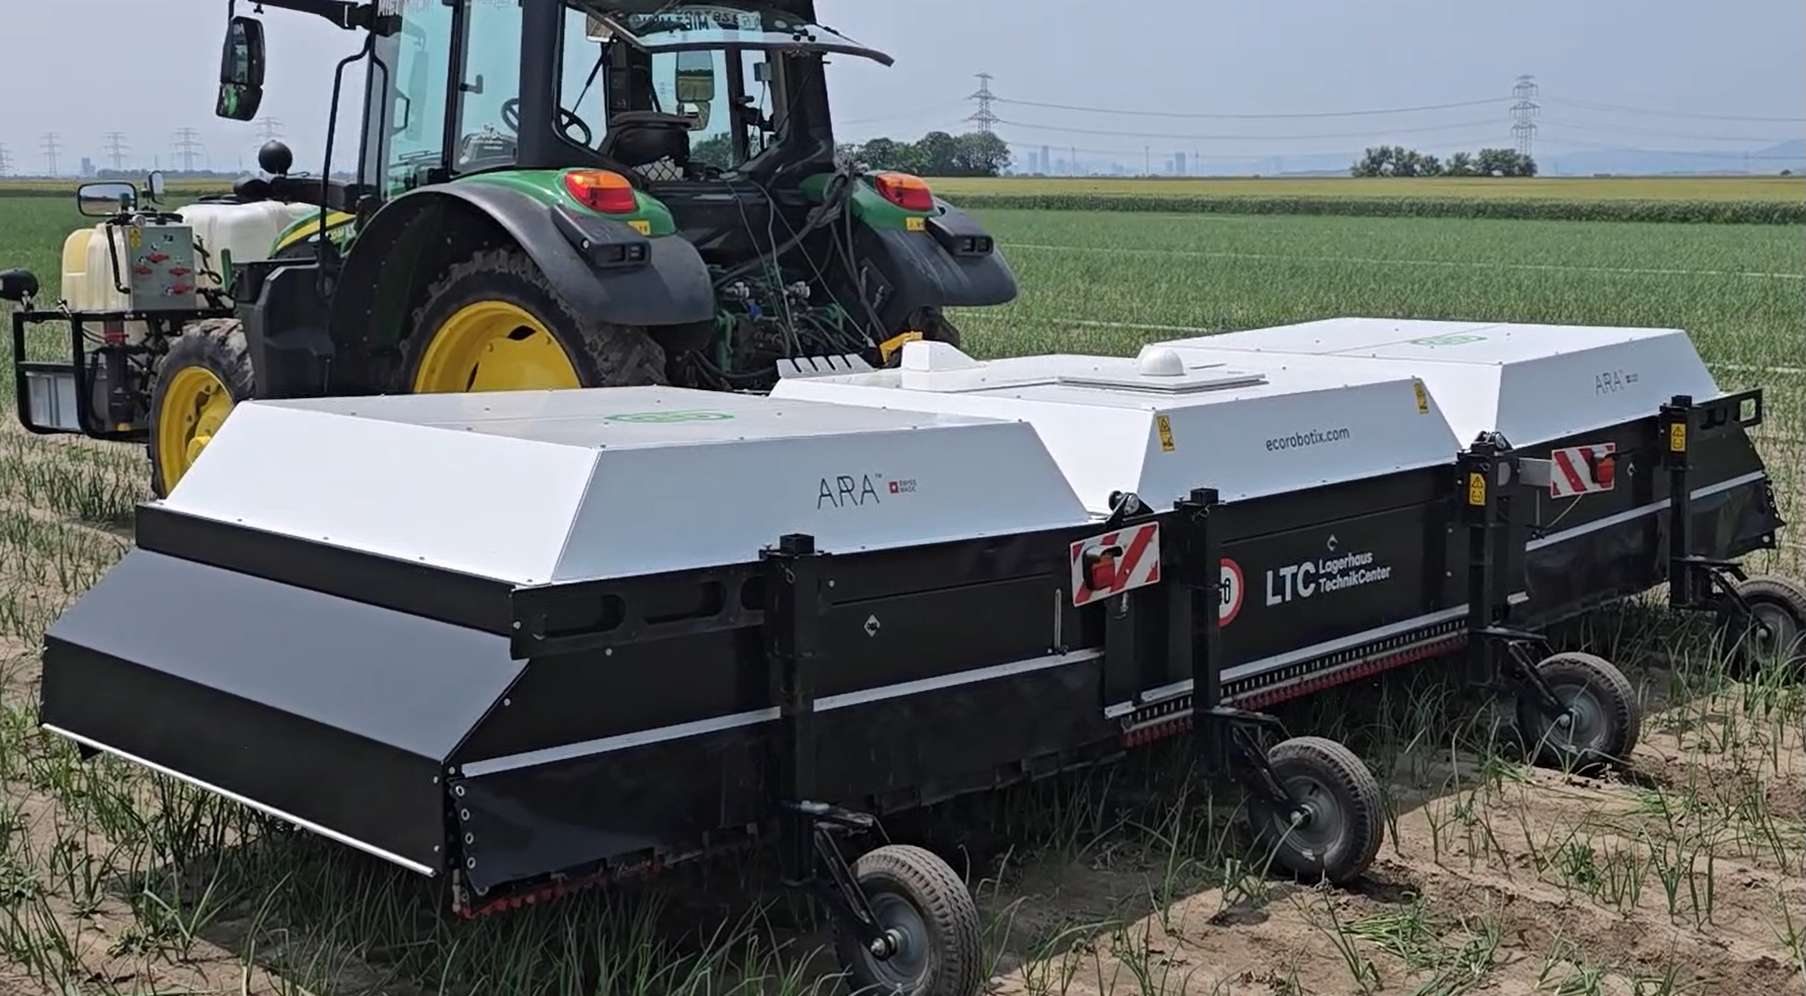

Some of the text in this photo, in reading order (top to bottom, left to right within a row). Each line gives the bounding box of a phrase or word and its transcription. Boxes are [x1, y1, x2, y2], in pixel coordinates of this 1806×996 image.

[1265, 428, 1350, 451] ecorobotix.com
[1318, 552, 1373, 574] Lagerhaus
[1265, 561, 1316, 607] LTC
[1318, 566, 1391, 593] TechnikCenter
